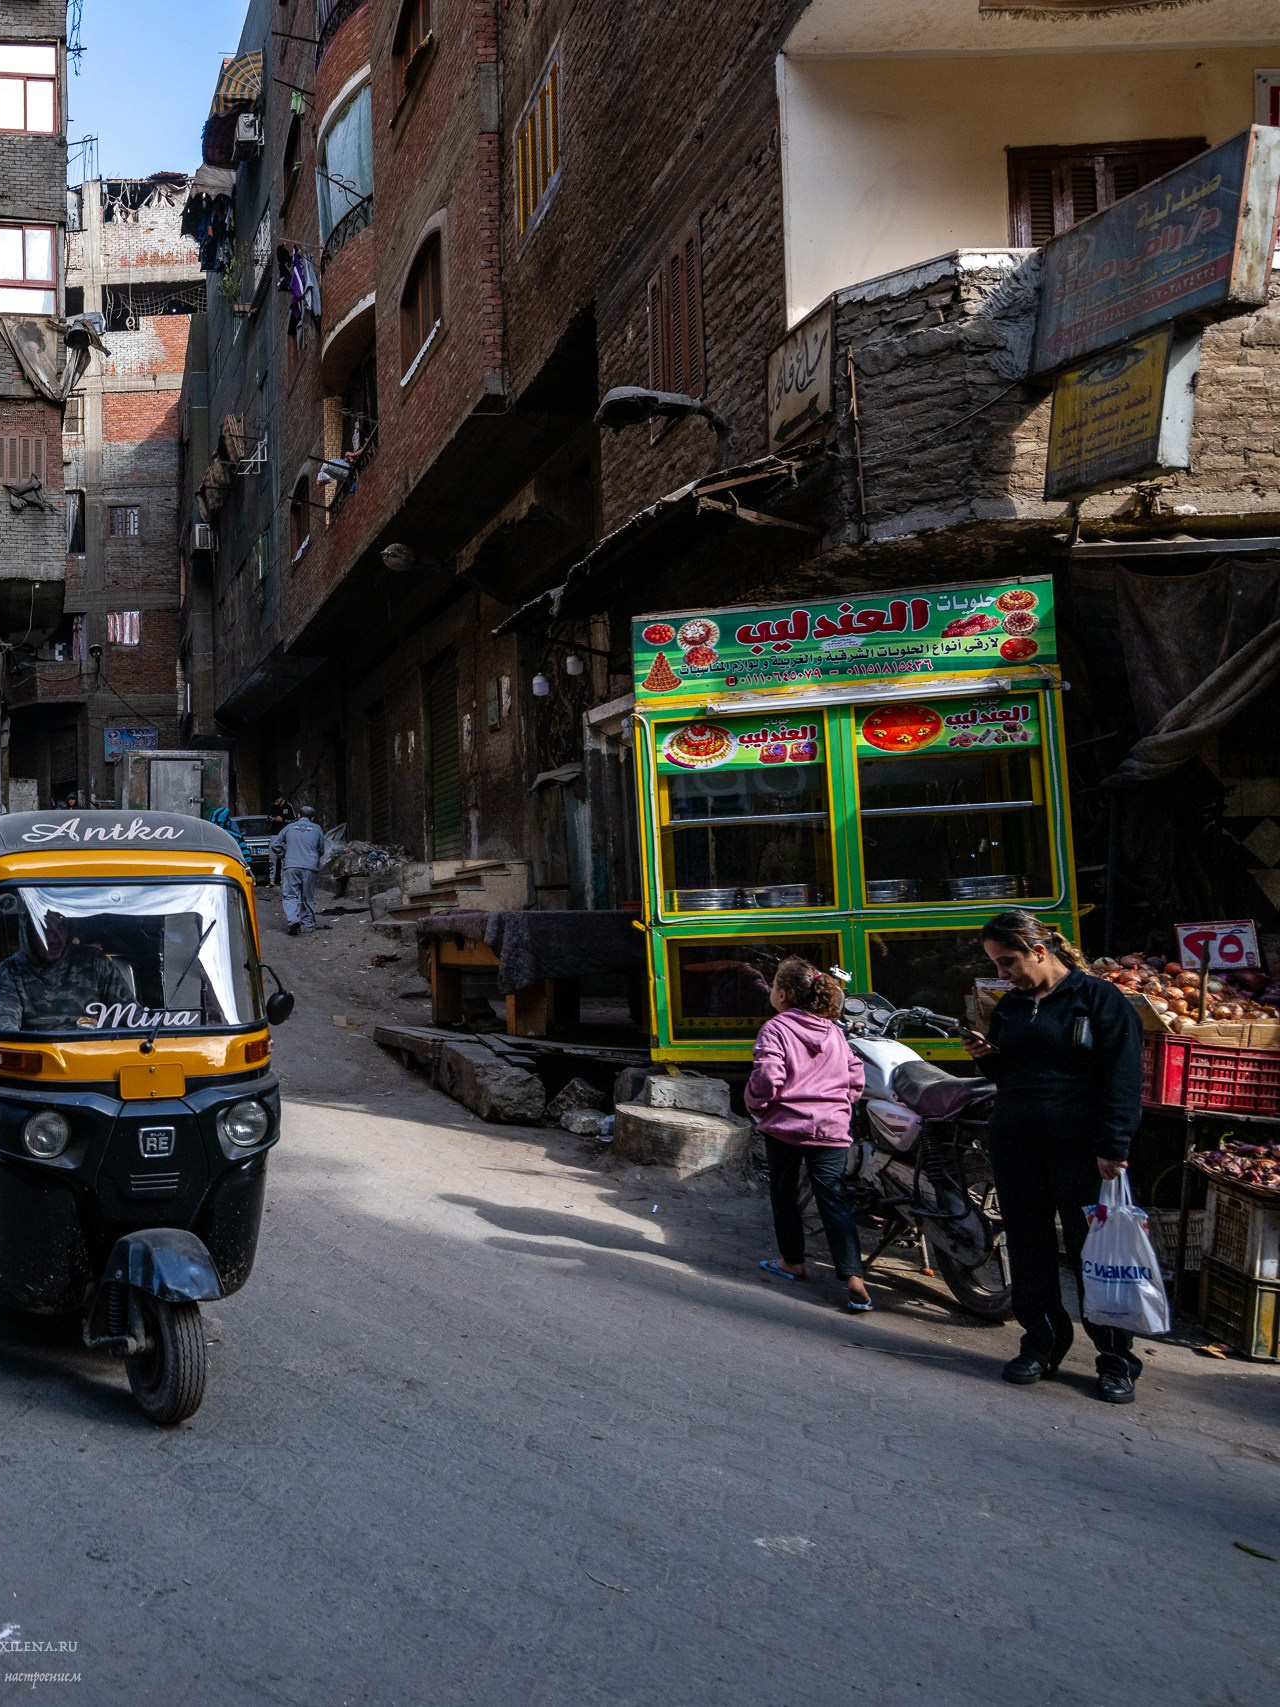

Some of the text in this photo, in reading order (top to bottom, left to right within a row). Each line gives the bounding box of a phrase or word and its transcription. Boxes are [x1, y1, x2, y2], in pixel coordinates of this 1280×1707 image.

[1135, 174, 1222, 230] صيدلية
[796, 329, 828, 393] شارع
[735, 593, 997, 655] العندليب حلويات
[825, 648, 874, 663] الشرقية
[877, 644, 929, 660] الحلويات
[931, 639, 962, 656] أنواع
[732, 658, 760, 673] لوازم
[771, 653, 814, 669] الغربية
[945, 705, 1031, 730] العندليب
[738, 724, 817, 749] العندليب
[22, 817, 184, 843] Antka
[86, 1002, 198, 1028] Mina
[146, 1136, 169, 1151] RE
